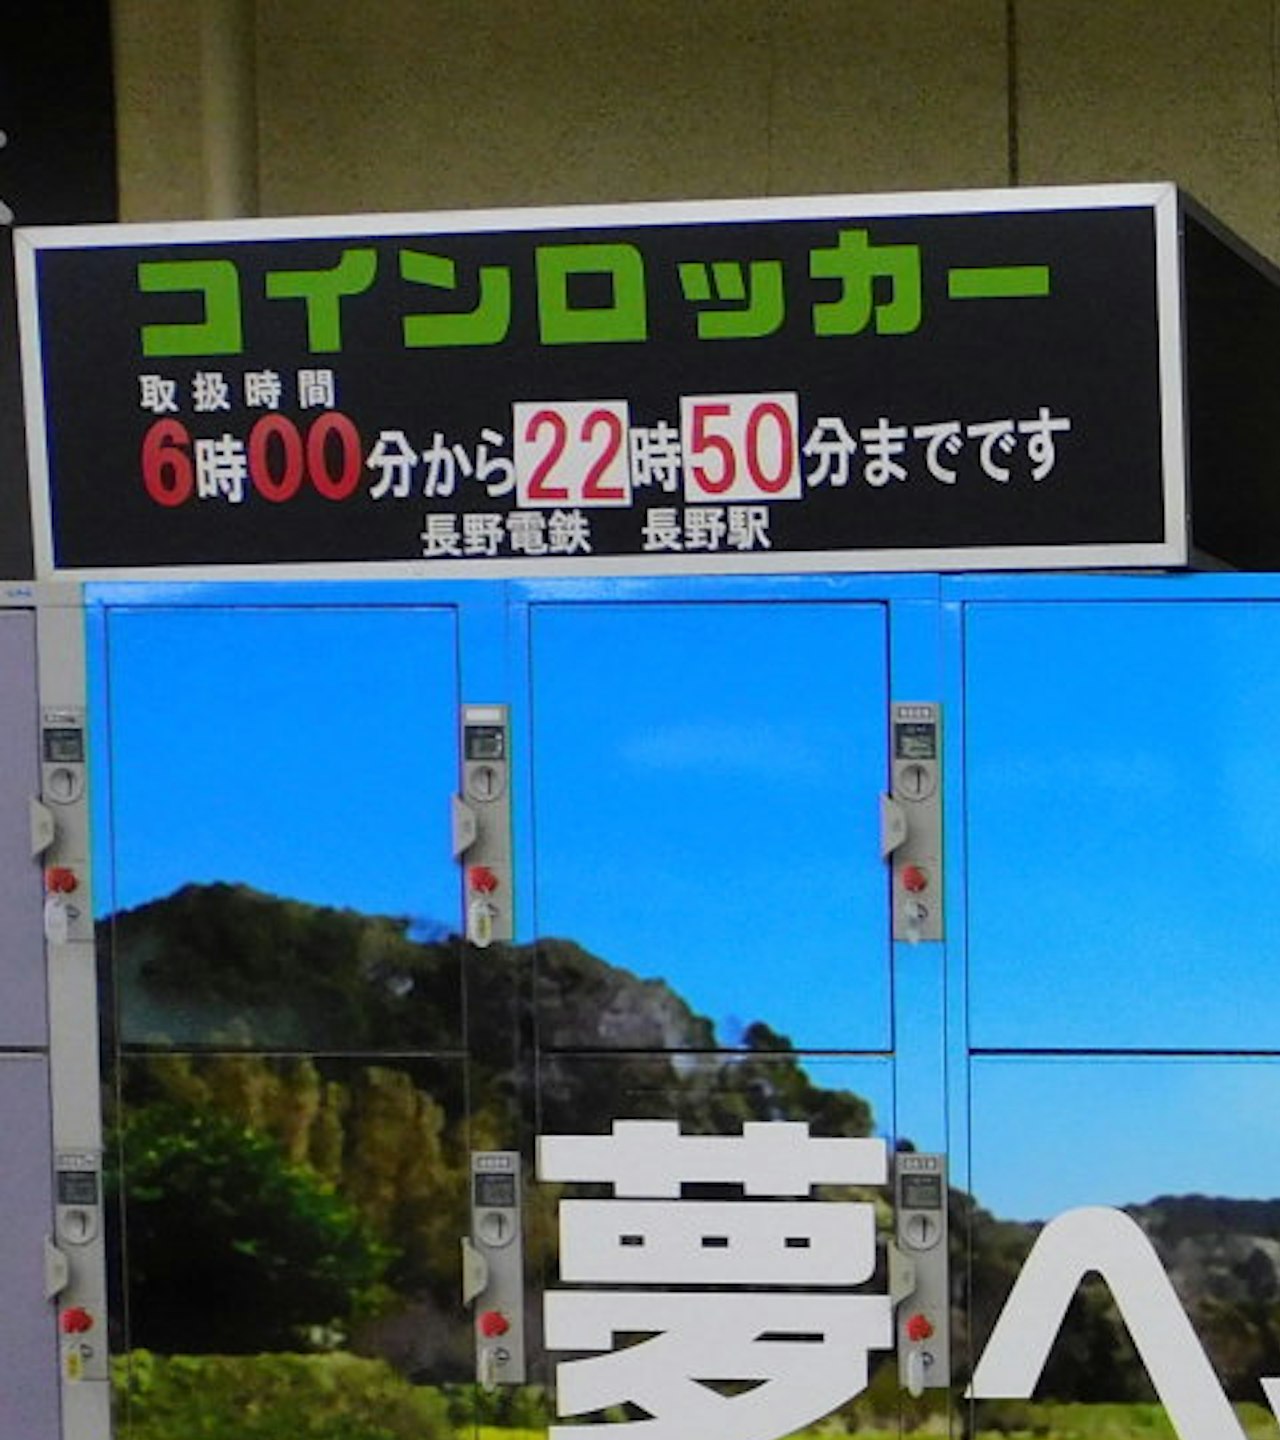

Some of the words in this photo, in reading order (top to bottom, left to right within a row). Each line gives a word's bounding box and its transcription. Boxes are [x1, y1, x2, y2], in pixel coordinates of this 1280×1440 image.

[138, 229, 1050, 357] コインロッカー
[140, 369, 335, 413] 取扱時間
[142, 405, 1071, 507] 6時00分から22時50分までです
[422, 513, 593, 558] 長野電鉄
[642, 511, 772, 554] 長野駅
